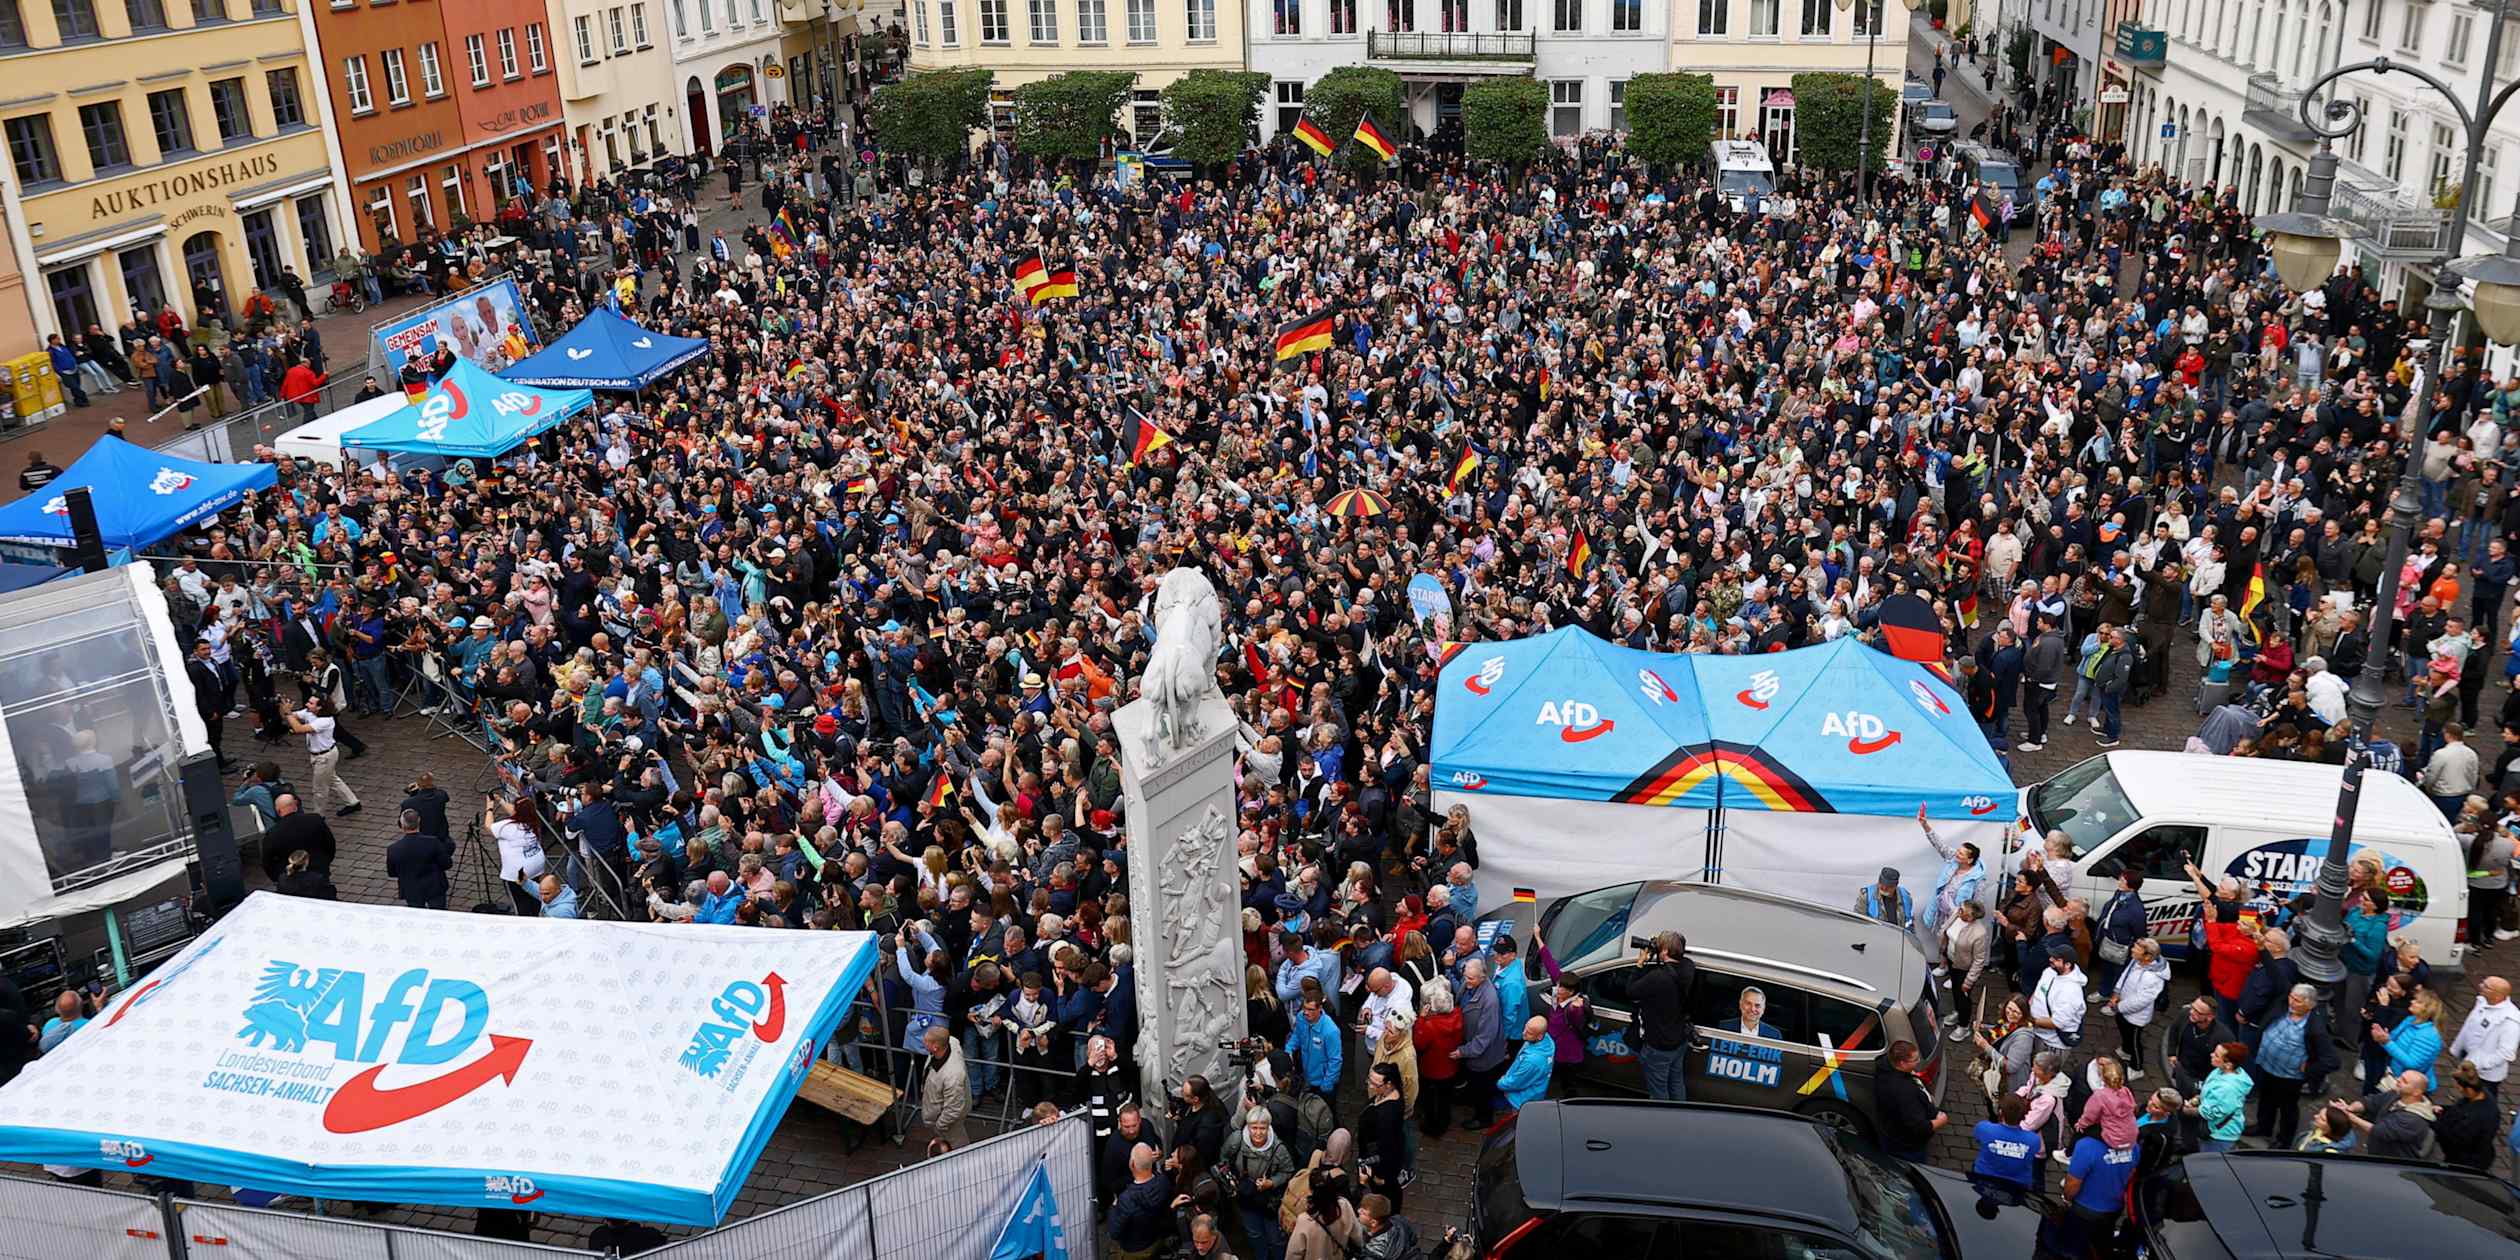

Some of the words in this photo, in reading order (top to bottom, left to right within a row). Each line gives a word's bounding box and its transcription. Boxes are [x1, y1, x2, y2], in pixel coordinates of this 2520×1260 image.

[91, 153, 278, 219] AUKTIONSHAUS
[170, 204, 226, 232] SCHWERIN
[386, 320, 439, 351] GEMEINSAM
[513, 378, 566, 387] GENERATION
[567, 378, 631, 387] DEUTSCHLAND
[491, 391, 531, 416] AfD
[1536, 699, 1599, 727] AfD
[1820, 711, 1884, 738] AfD
[1452, 771, 1481, 784] AfD
[1961, 795, 1992, 808] AfD
[307, 968, 490, 1065] AfD
[698, 980, 765, 1050] AfD
[1595, 1039, 1629, 1056] AfD
[1711, 1038, 1782, 1062] LEIF-ERIK
[215, 1047, 336, 1082] Landesverband
[1709, 1055, 1778, 1085] HOLM
[203, 1071, 335, 1106] SACHSEN-ANHALT
[499, 1176, 535, 1194] AfD
